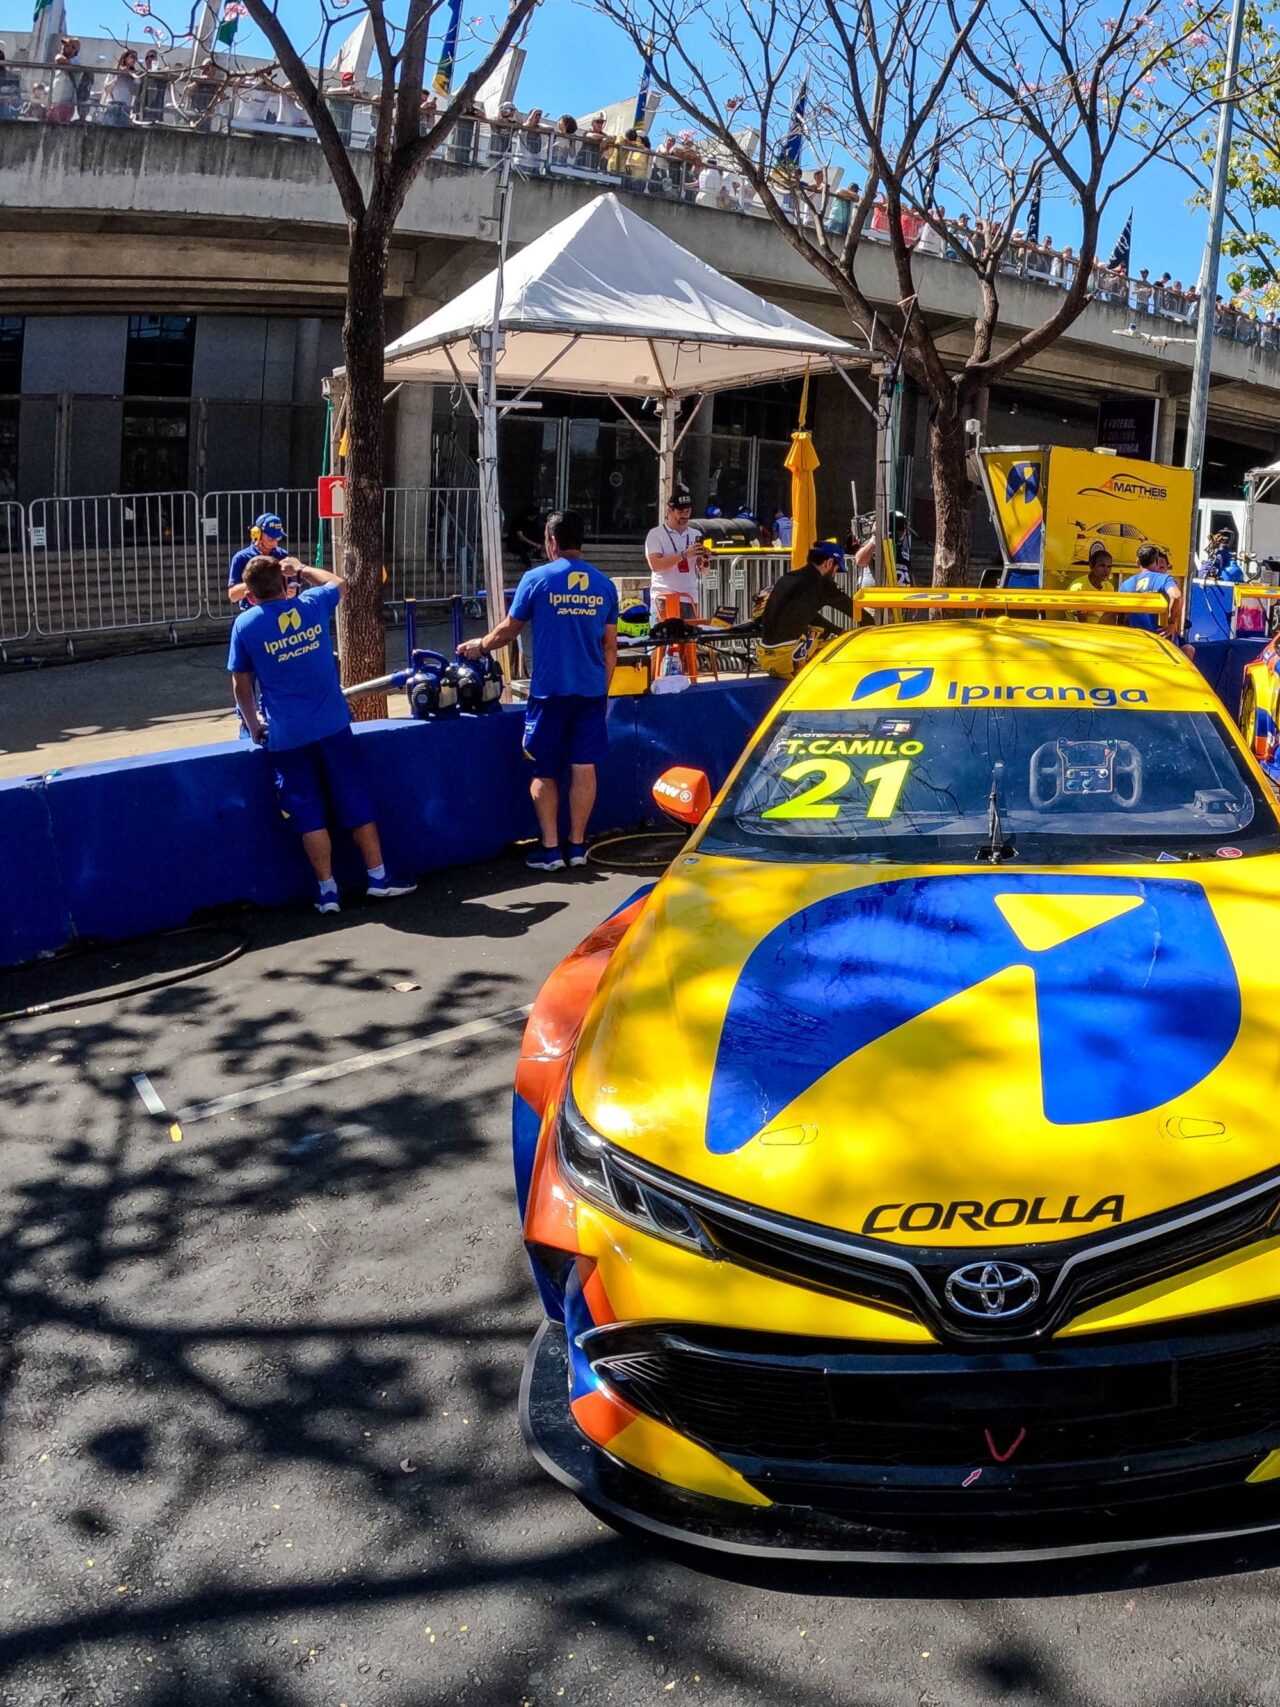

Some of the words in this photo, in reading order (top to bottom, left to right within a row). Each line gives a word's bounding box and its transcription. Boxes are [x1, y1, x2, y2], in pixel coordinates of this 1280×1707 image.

[549, 592, 604, 607] Ipiranga
[557, 608, 597, 616] RACING
[264, 624, 323, 655] Ipiranga
[278, 640, 320, 662] RACING
[947, 681, 1149, 707] Ipiranga
[785, 739, 925, 756] T.CAMILO
[760, 757, 912, 819] 21
[861, 1194, 1125, 1235] COROLLA
